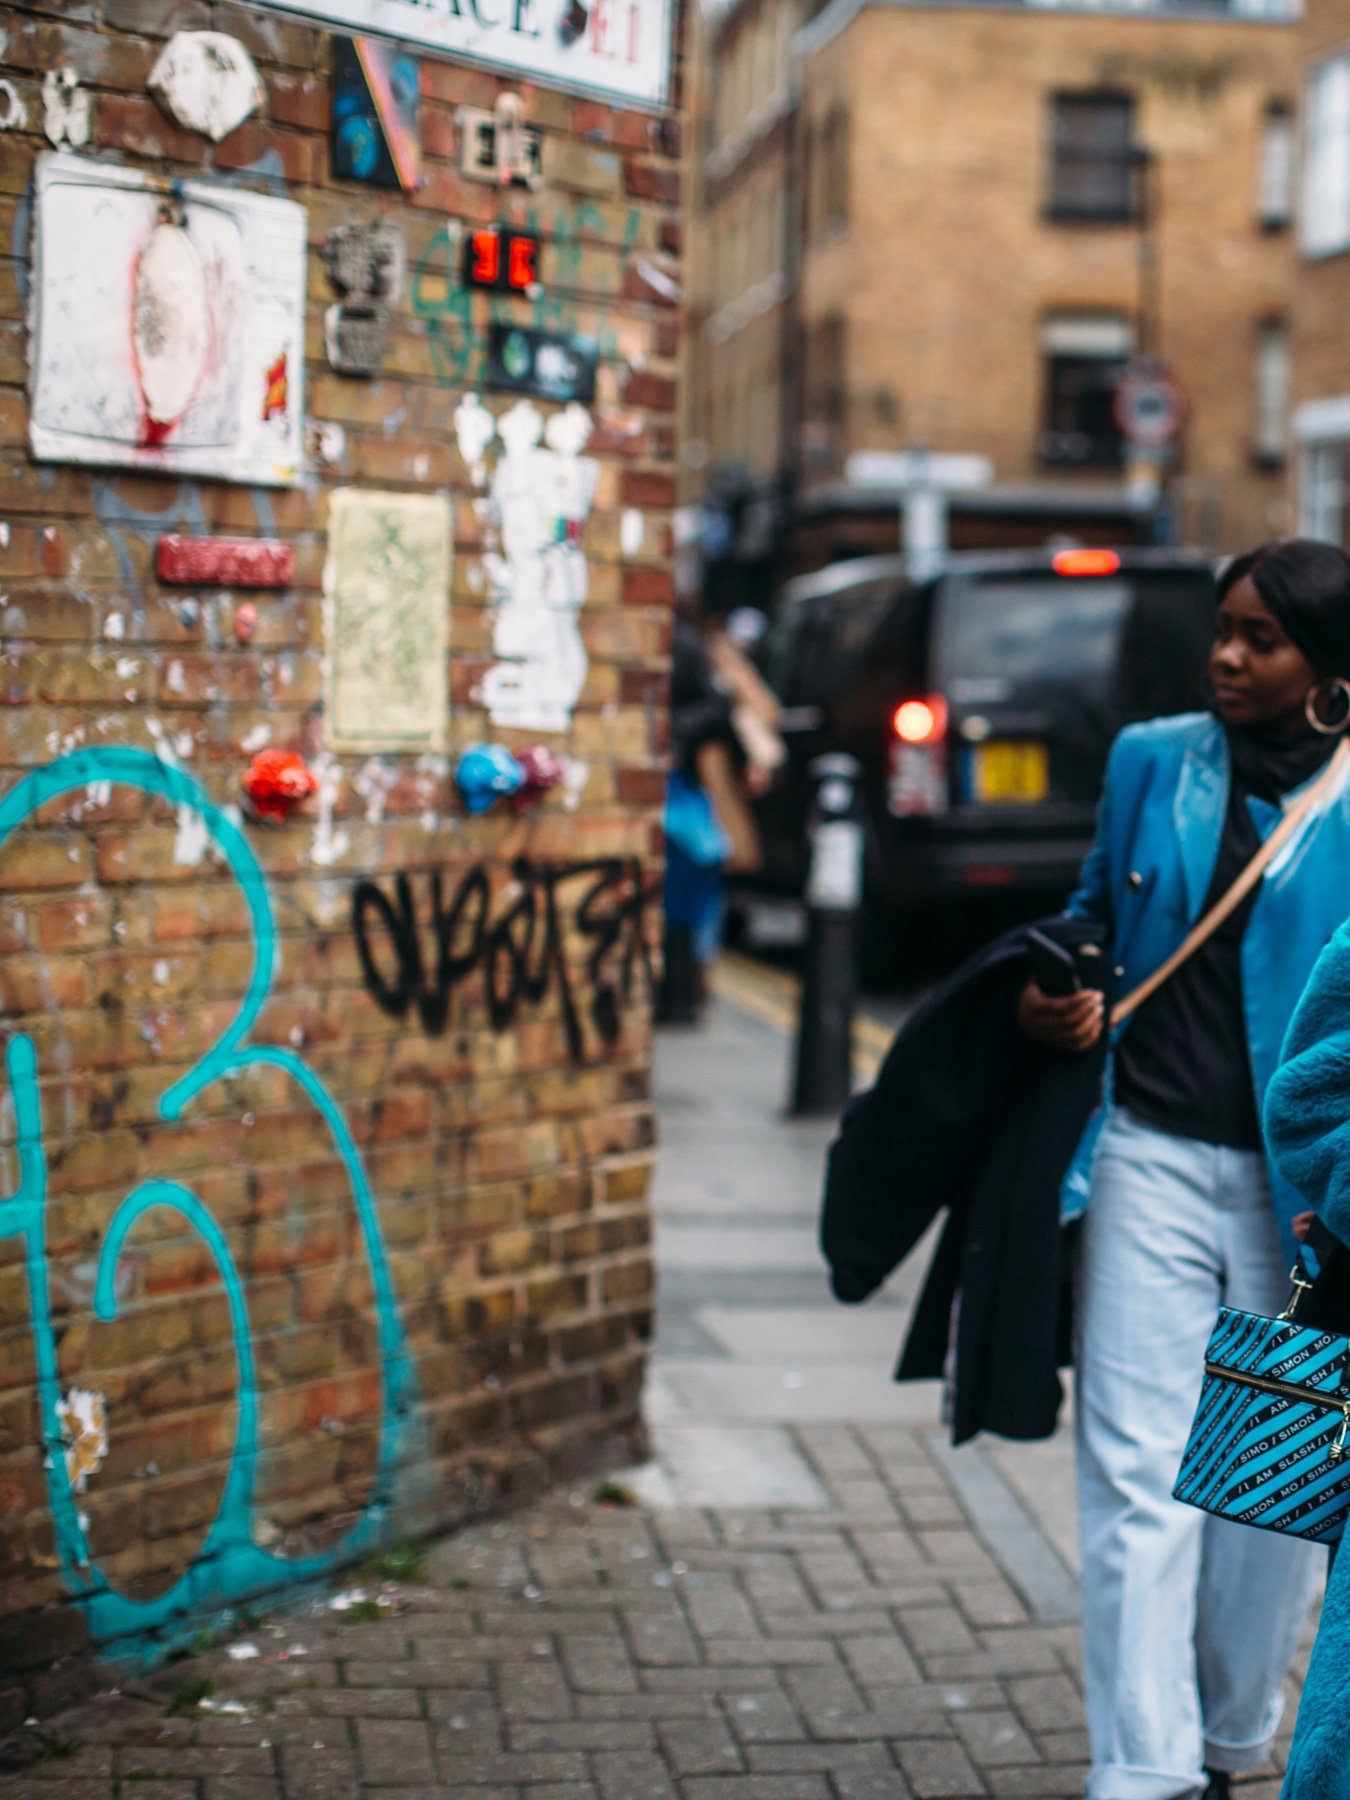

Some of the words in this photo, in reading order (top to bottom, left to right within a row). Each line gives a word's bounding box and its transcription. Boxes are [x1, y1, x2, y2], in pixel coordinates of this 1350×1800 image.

[1271, 1348, 1311, 1377] SIMON
[1269, 1400, 1290, 1416] AM
[1239, 1441, 1269, 1464] SIMO
[1278, 1412, 1316, 1441] SIMON
[1255, 1469, 1274, 1485] AM
[1278, 1441, 1316, 1471] SLASH
[1280, 1482, 1299, 1498] MO
[1307, 1459, 1336, 1482] SIMO
[1318, 1487, 1336, 1504] AM
[1302, 1512, 1342, 1538] SIMON
